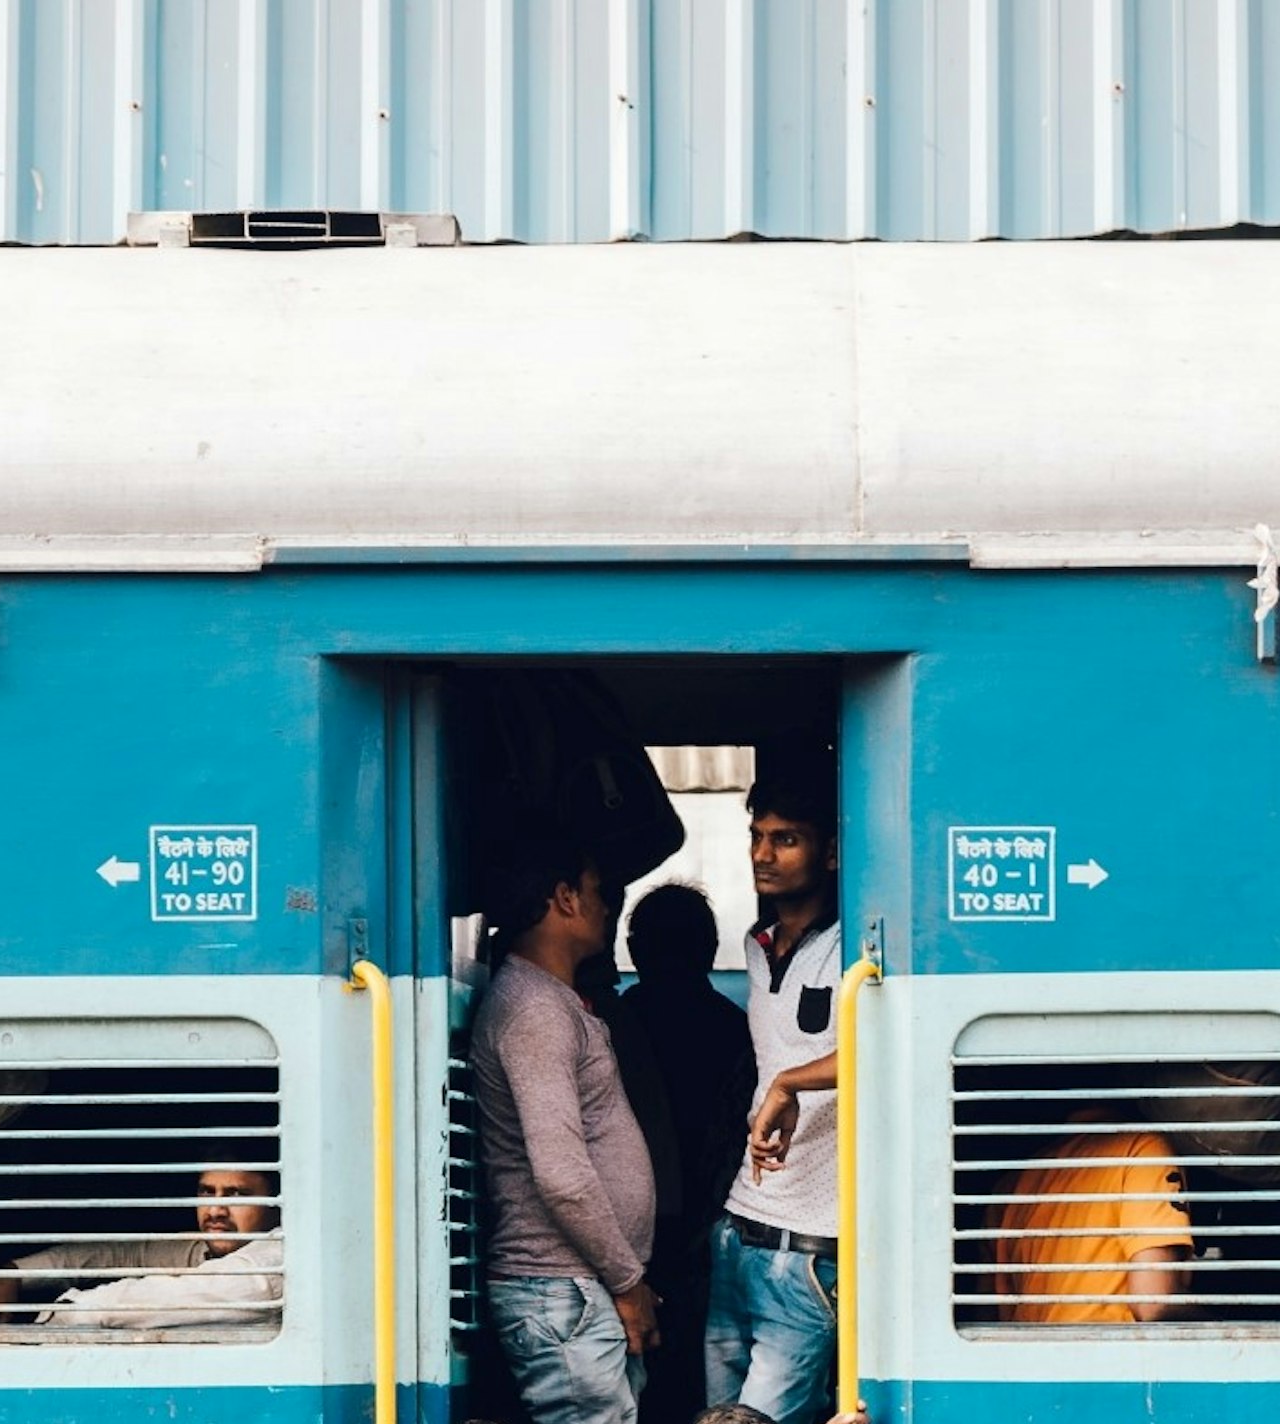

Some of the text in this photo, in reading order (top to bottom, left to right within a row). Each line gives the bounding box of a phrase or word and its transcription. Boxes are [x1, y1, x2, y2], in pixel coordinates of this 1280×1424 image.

[162, 893, 245, 912] TO SEAT
[959, 893, 1044, 912] TO SEAT
